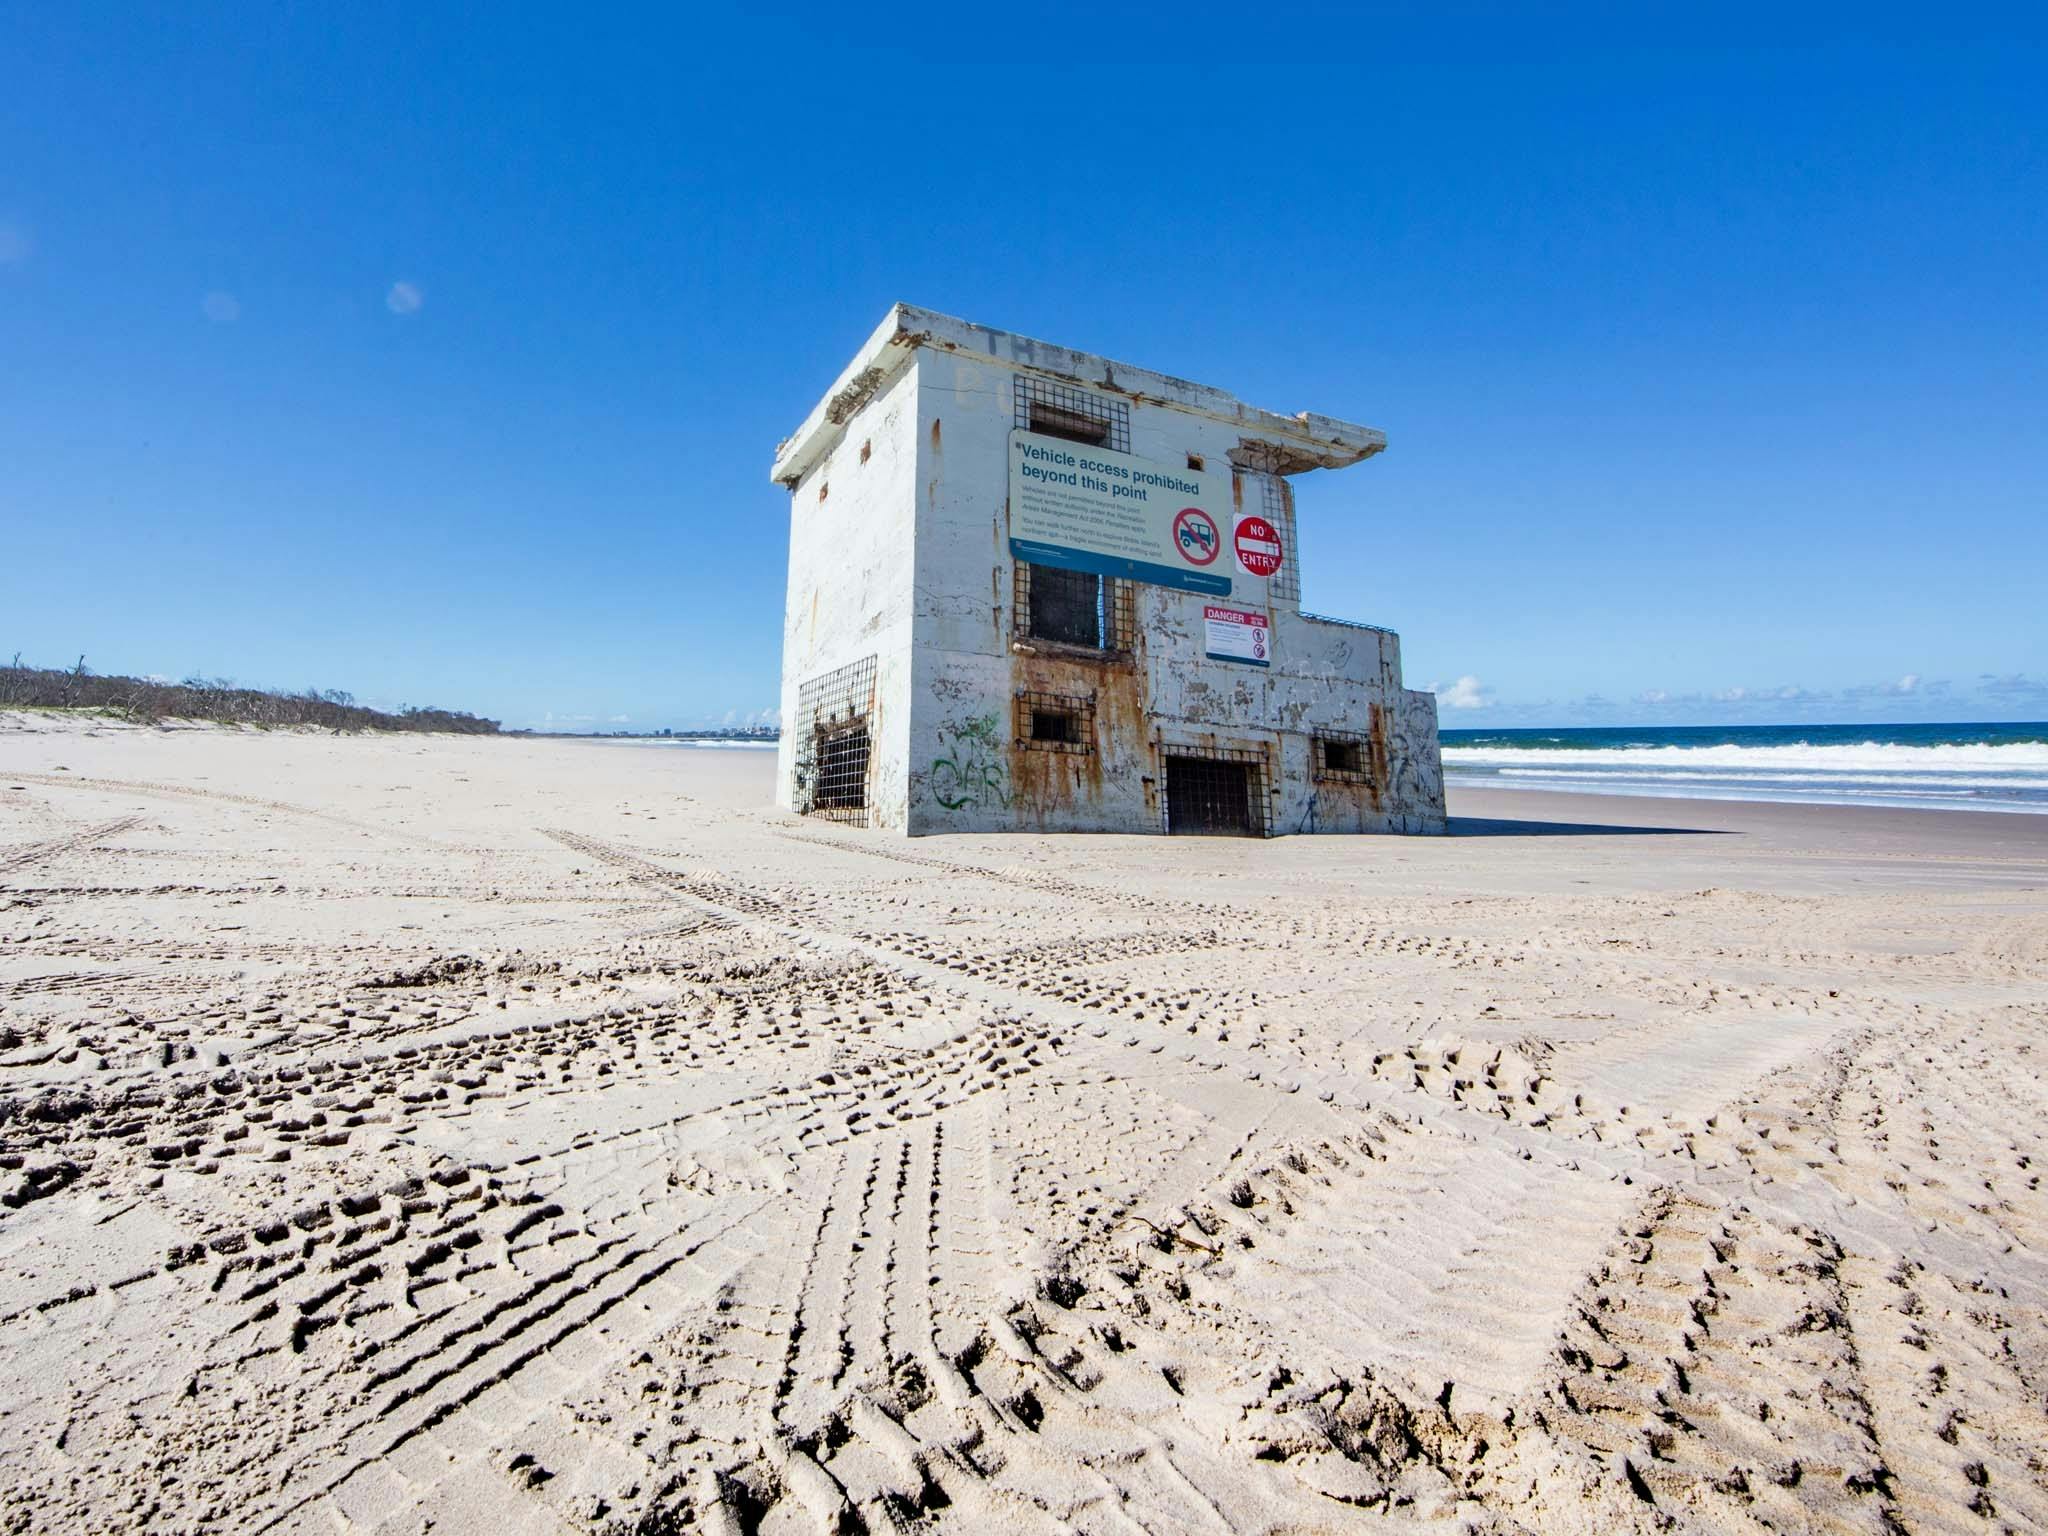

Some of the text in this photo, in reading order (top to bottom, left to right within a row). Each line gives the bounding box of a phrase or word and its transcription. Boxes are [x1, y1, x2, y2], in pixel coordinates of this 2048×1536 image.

[1021, 443, 1200, 496] Vehicle access prohibited
[1022, 463, 1148, 501] beyond this point
[1250, 524, 1265, 537] NO
[1242, 553, 1276, 568] ENTRY
[1207, 609, 1245, 624] DANGER
